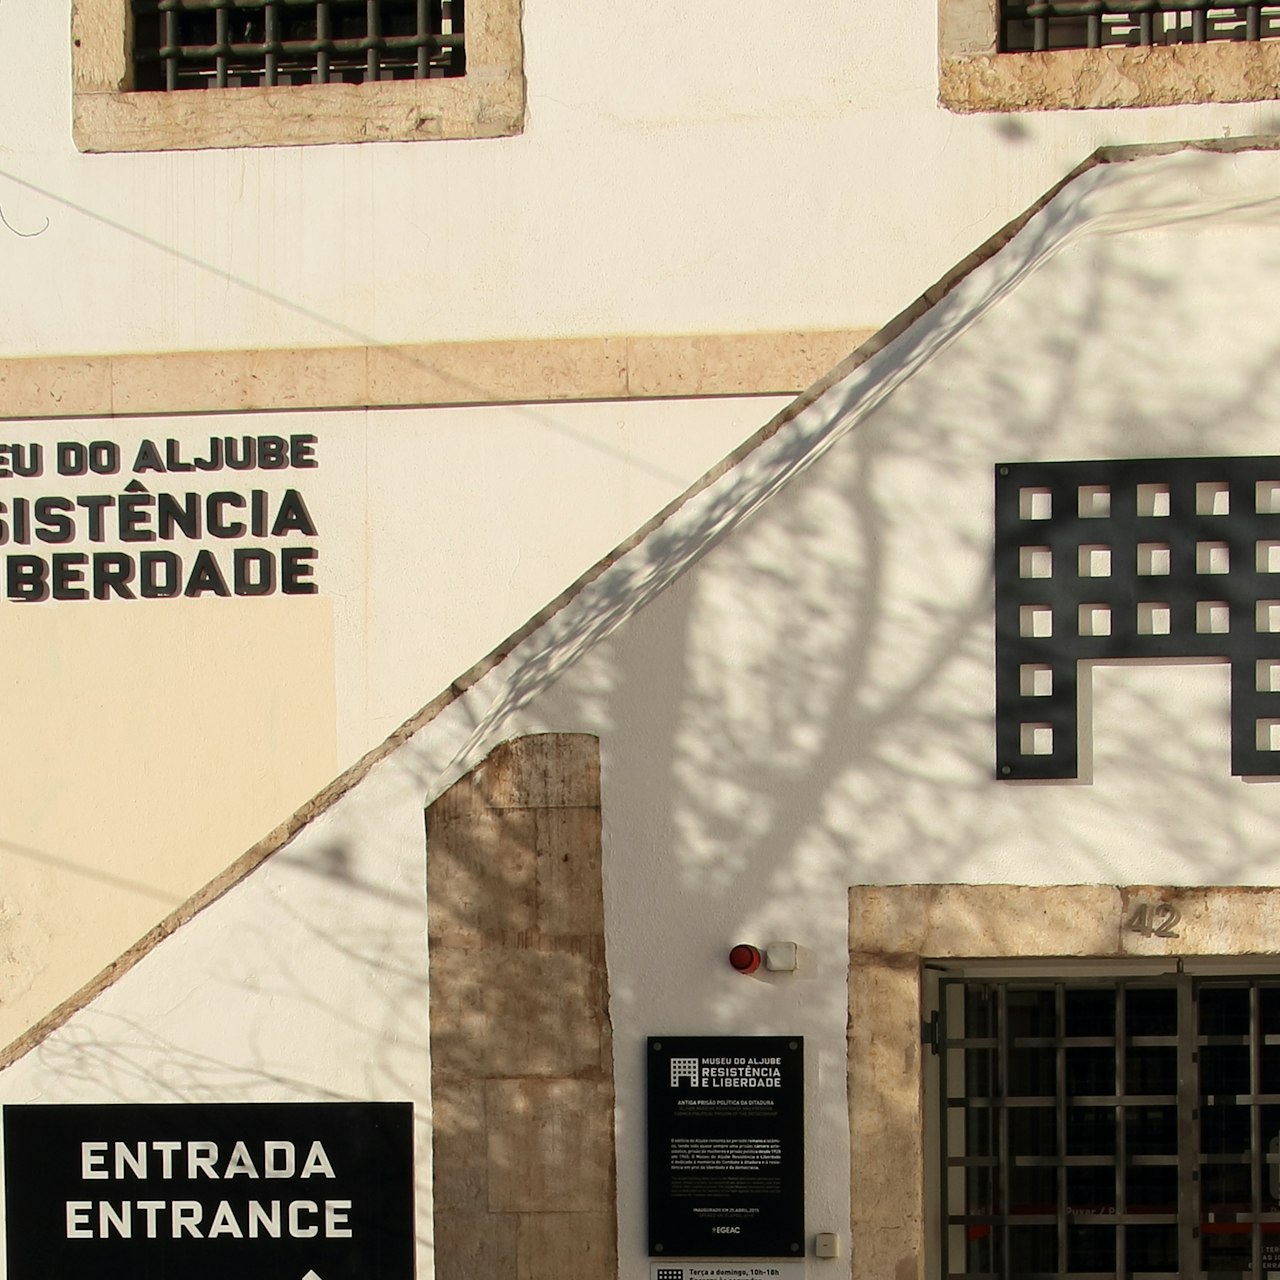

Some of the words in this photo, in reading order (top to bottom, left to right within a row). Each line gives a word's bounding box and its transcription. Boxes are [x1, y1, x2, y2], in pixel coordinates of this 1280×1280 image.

[57, 440, 120, 475] DO
[132, 434, 319, 474] ALJUBE
[1125, 903, 1181, 938] 42
[701, 1057, 732, 1065] MUSEU
[734, 1057, 746, 1065] DO
[747, 1057, 781, 1065] ALJUBE
[701, 1065, 781, 1077] RESISTÊNCIA
[701, 1078, 709, 1088] E
[712, 1078, 781, 1088] LIBERDADE
[81, 1140, 336, 1179] ENTRADA
[66, 1200, 352, 1238] ENTRANCE
[716, 1226, 741, 1234] EGEAC
[716, 1269, 748, 1277] domingo,
